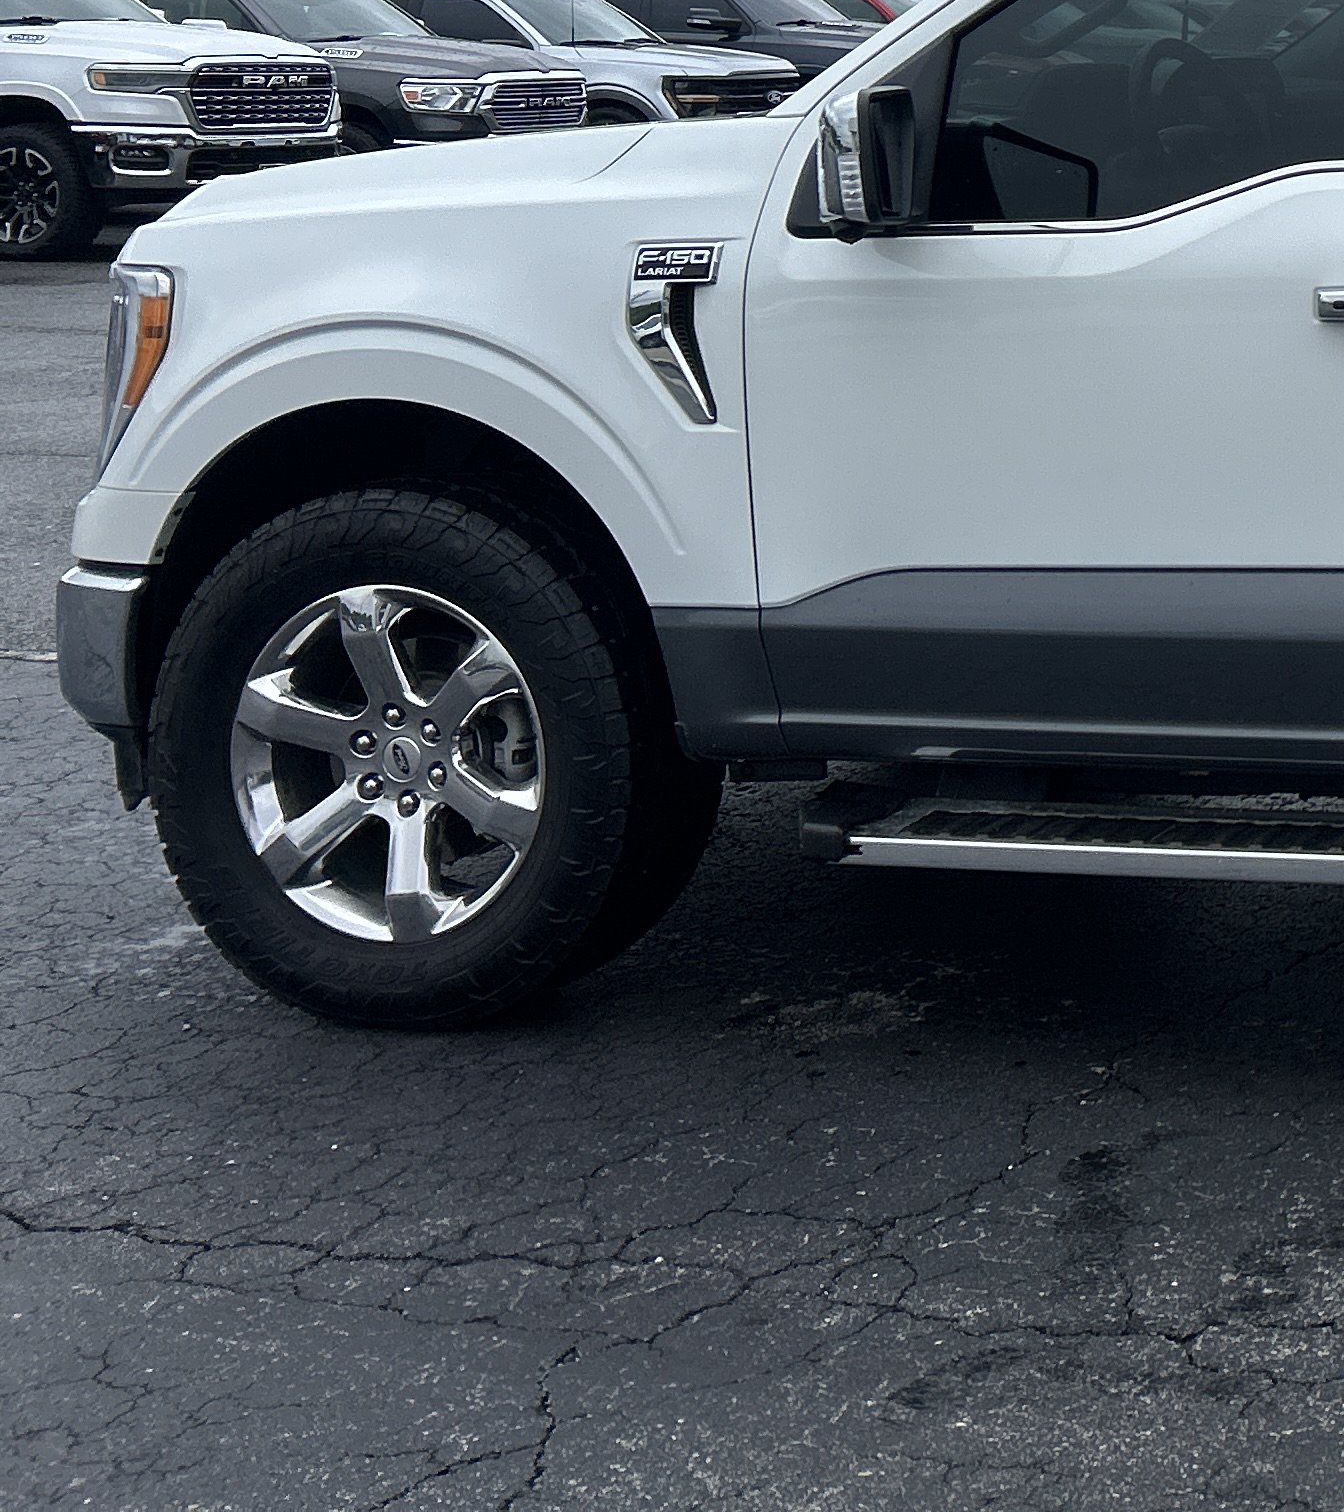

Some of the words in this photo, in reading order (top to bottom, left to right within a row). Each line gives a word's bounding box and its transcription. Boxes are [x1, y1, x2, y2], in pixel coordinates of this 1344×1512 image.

[242, 75, 309, 88] RAM
[529, 96, 571, 108] RAM
[638, 249, 710, 265] F-150
[637, 266, 684, 276] LARIAT
